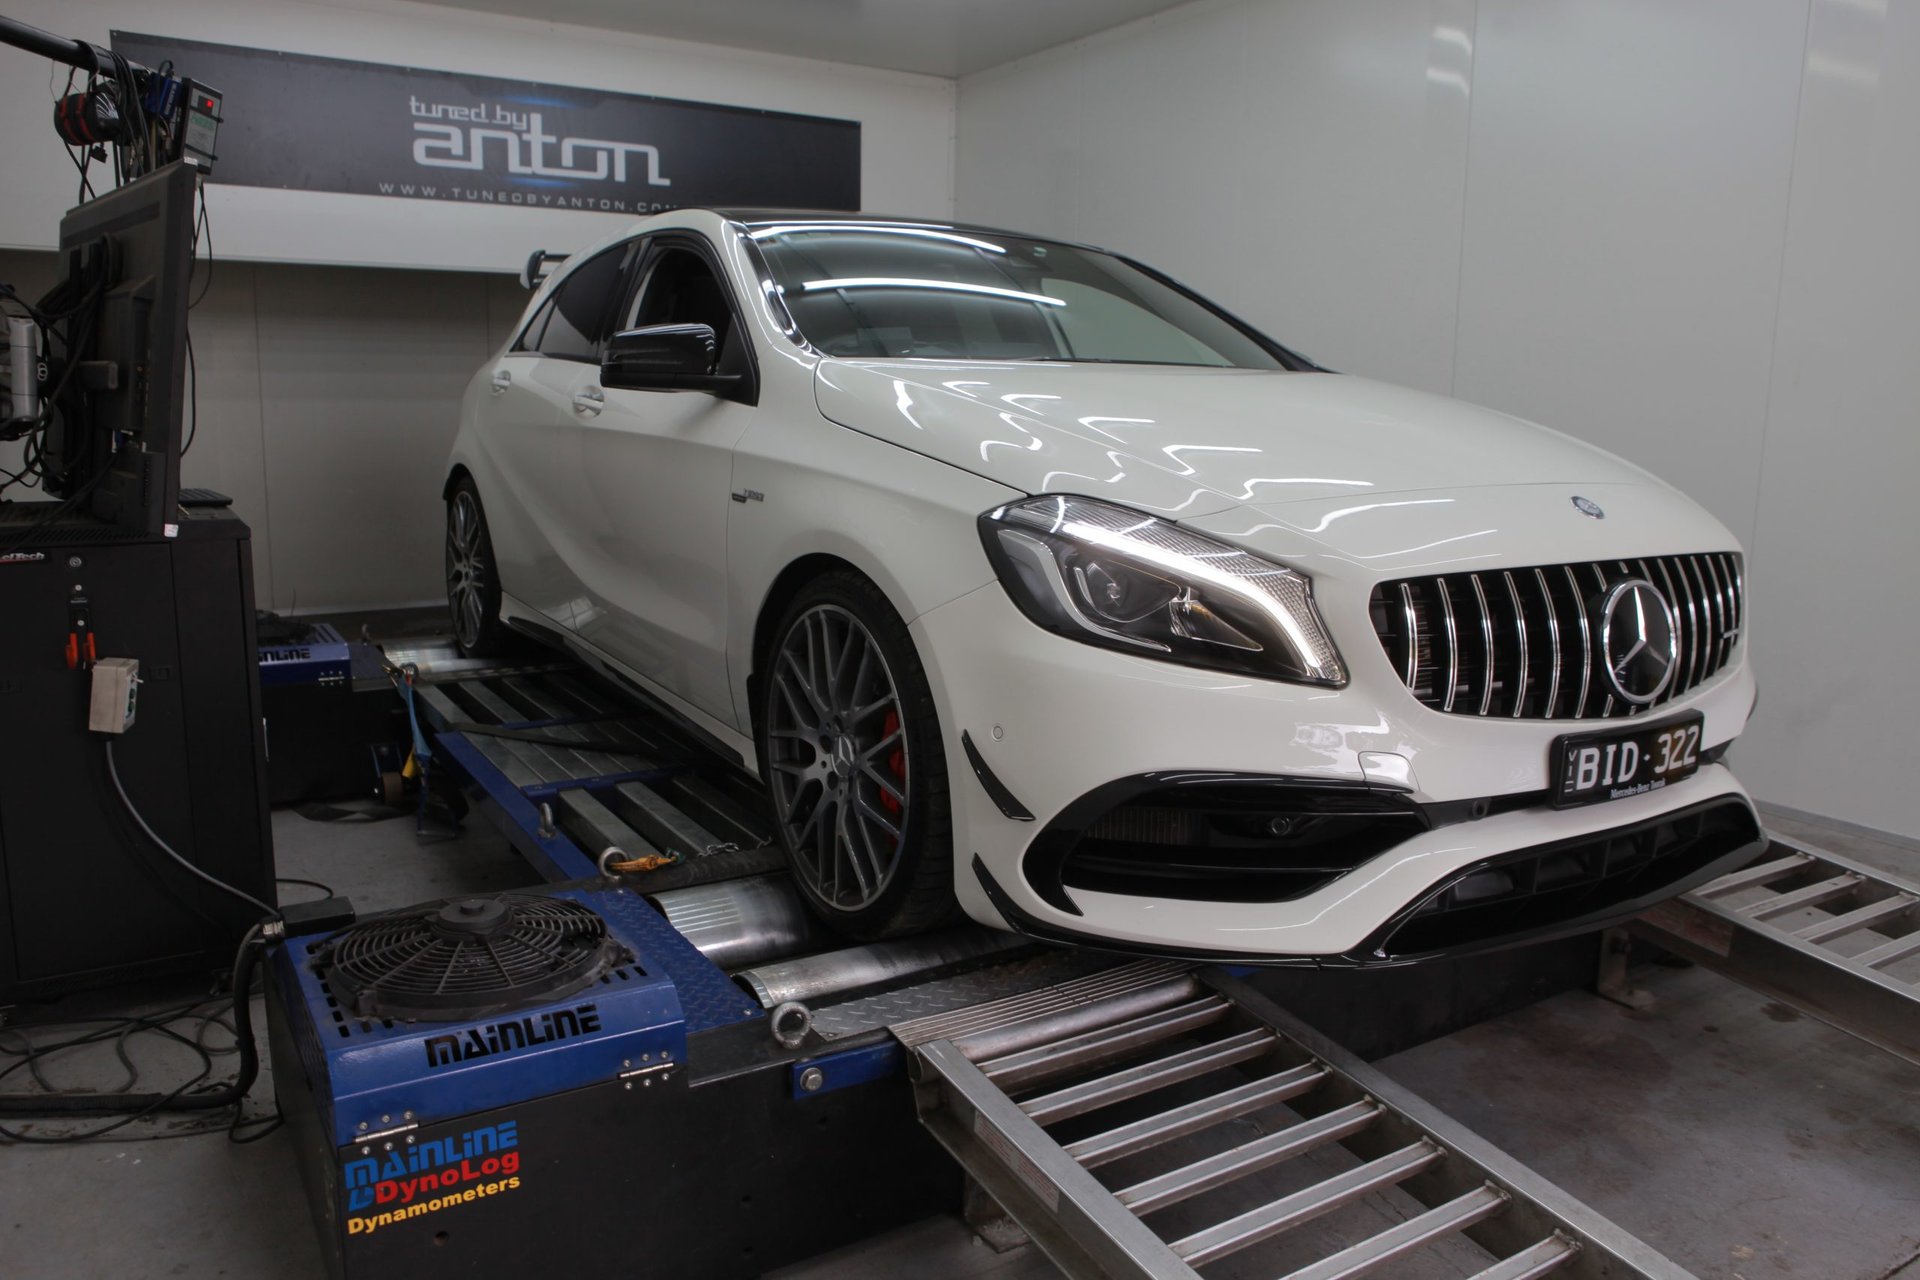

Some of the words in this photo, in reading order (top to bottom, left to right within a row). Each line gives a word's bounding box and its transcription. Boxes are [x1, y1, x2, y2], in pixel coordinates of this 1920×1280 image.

[409, 95, 489, 121] tuned
[491, 105, 527, 129] by
[413, 113, 671, 186] anton
[378, 182, 678, 212] WWW.TUNEDBYANTON.CO
[1576, 741, 1639, 790] BID
[1654, 725, 1699, 774] 322
[347, 1176, 521, 1235] Dynamometers
[375, 1151, 520, 1204] DynoLog
